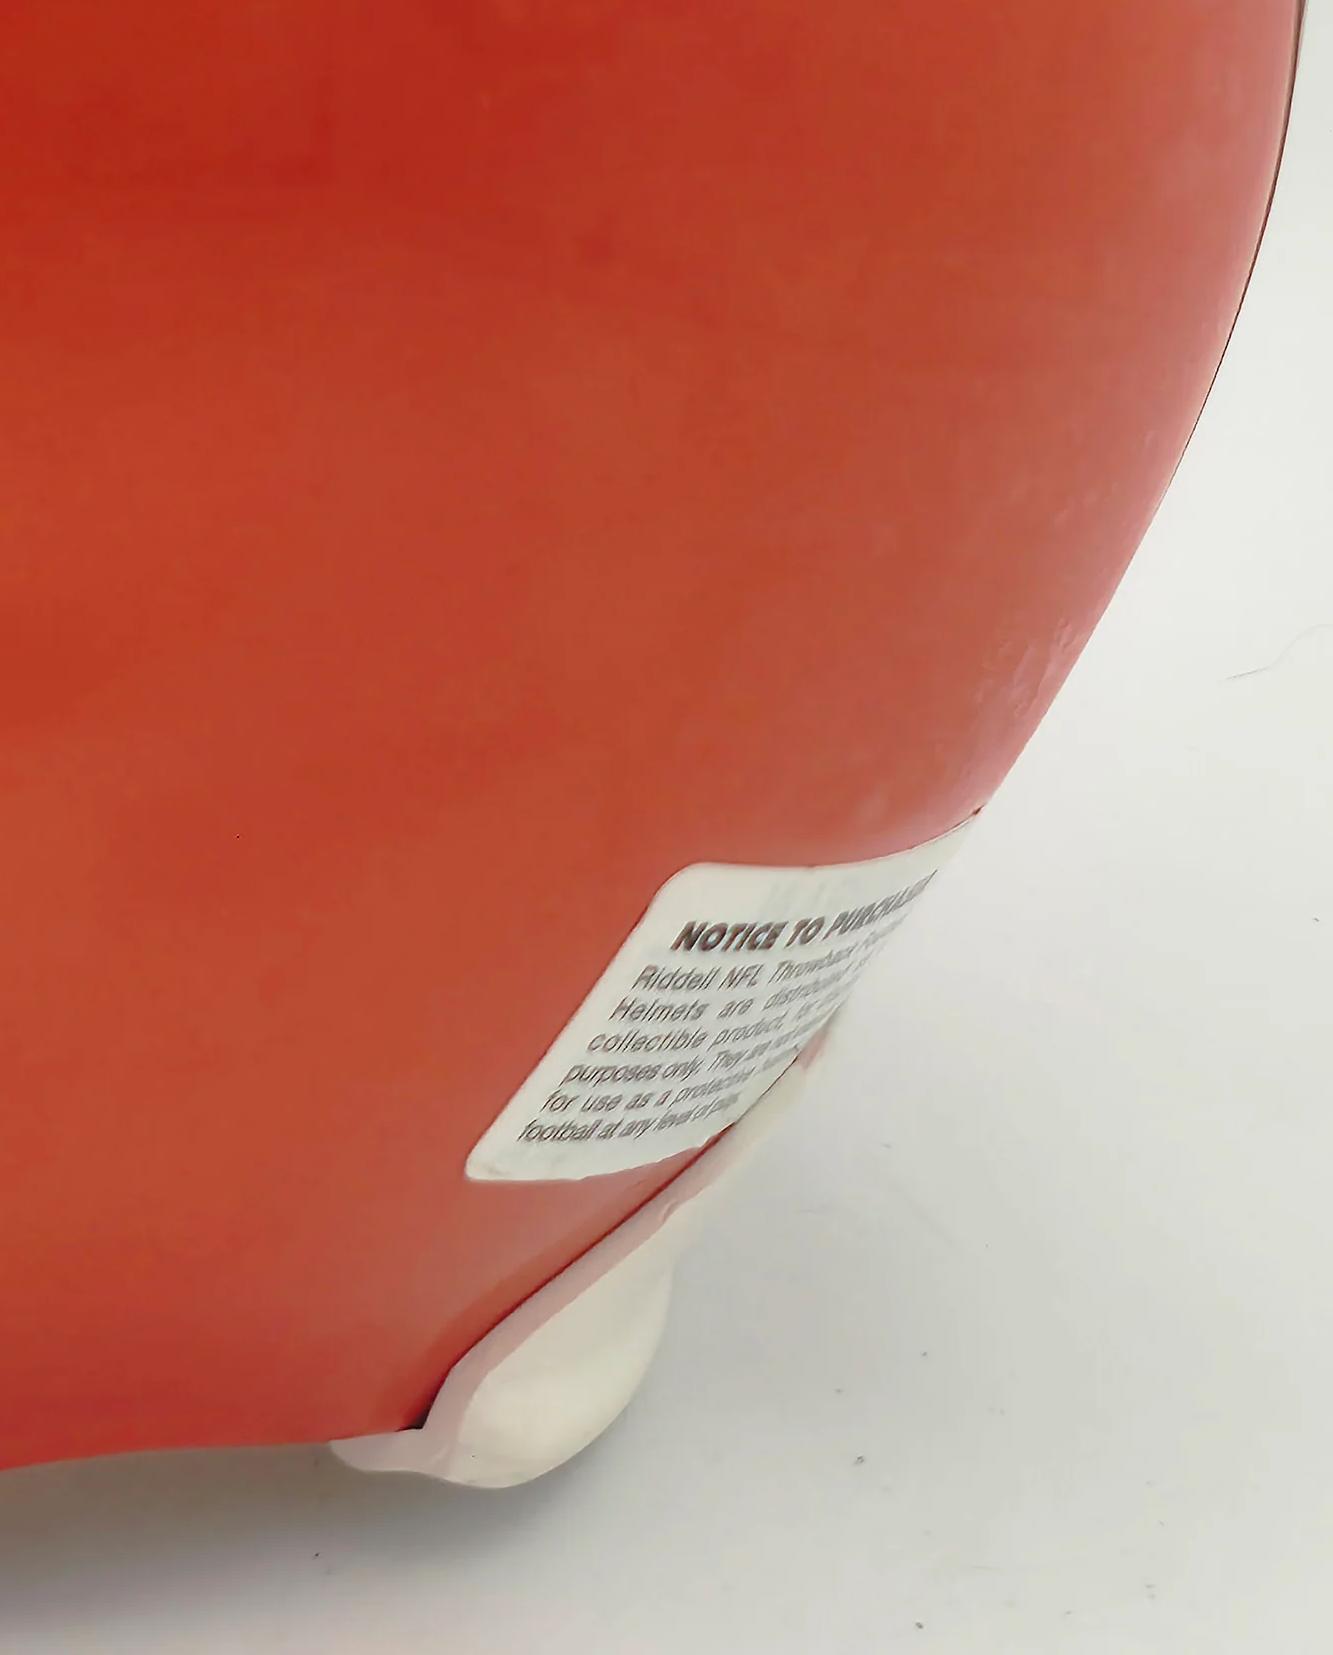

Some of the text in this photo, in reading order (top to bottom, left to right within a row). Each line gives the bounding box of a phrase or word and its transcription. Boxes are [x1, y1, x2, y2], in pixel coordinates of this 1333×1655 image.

[670, 921, 789, 952] NOTICE
[783, 916, 826, 949] TO
[631, 964, 723, 991] Riddell
[718, 964, 766, 991] NFL
[608, 996, 711, 1022] Helmets
[716, 997, 755, 1020] are
[588, 1027, 709, 1053] collectible
[558, 1064, 661, 1088] purposes
[539, 1089, 581, 1113] for
[581, 1095, 621, 1113] use
[624, 1092, 650, 1111] as
[653, 1089, 673, 1106] a
[517, 1119, 602, 1143] football
[595, 1117, 624, 1140] at
[618, 1118, 657, 1140] any
